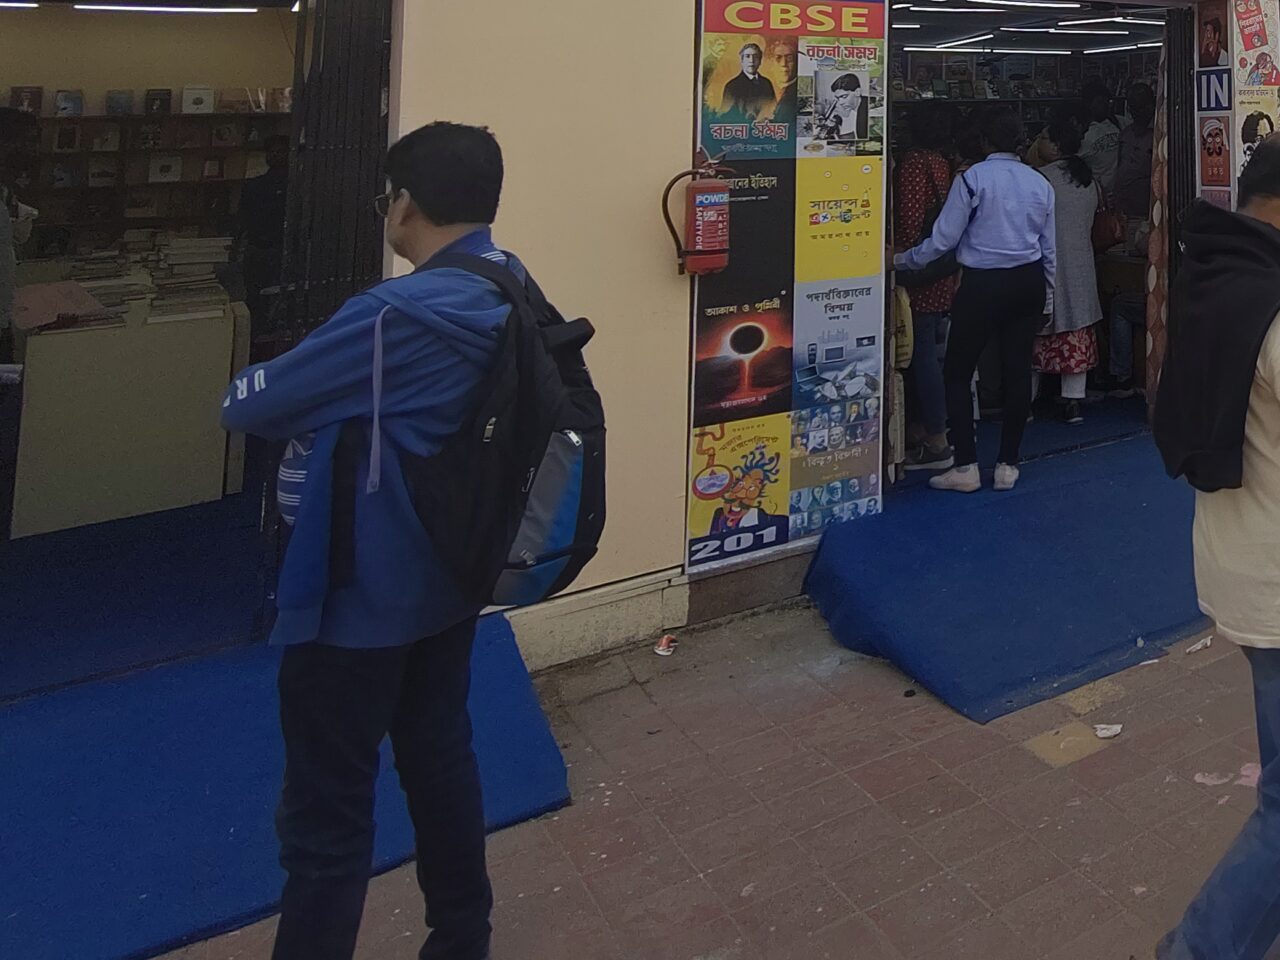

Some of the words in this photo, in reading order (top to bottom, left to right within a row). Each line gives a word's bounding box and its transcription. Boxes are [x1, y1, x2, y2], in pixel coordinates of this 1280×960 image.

[724, 1, 869, 33] CBSE
[807, 43, 841, 61] রচনা
[843, 45, 878, 62] সমগ্র
[1201, 74, 1229, 108] IN
[710, 123, 748, 139] রচনা
[751, 120, 789, 141] সমগ্র
[750, 173, 778, 190] ইতিহাস
[806, 286, 873, 303] পদার্থবিজ্ঞানের
[704, 305, 737, 317] আকাশ
[742, 304, 750, 312] ও
[755, 297, 780, 313] পৃথিবী
[690, 526, 777, 561] 201
